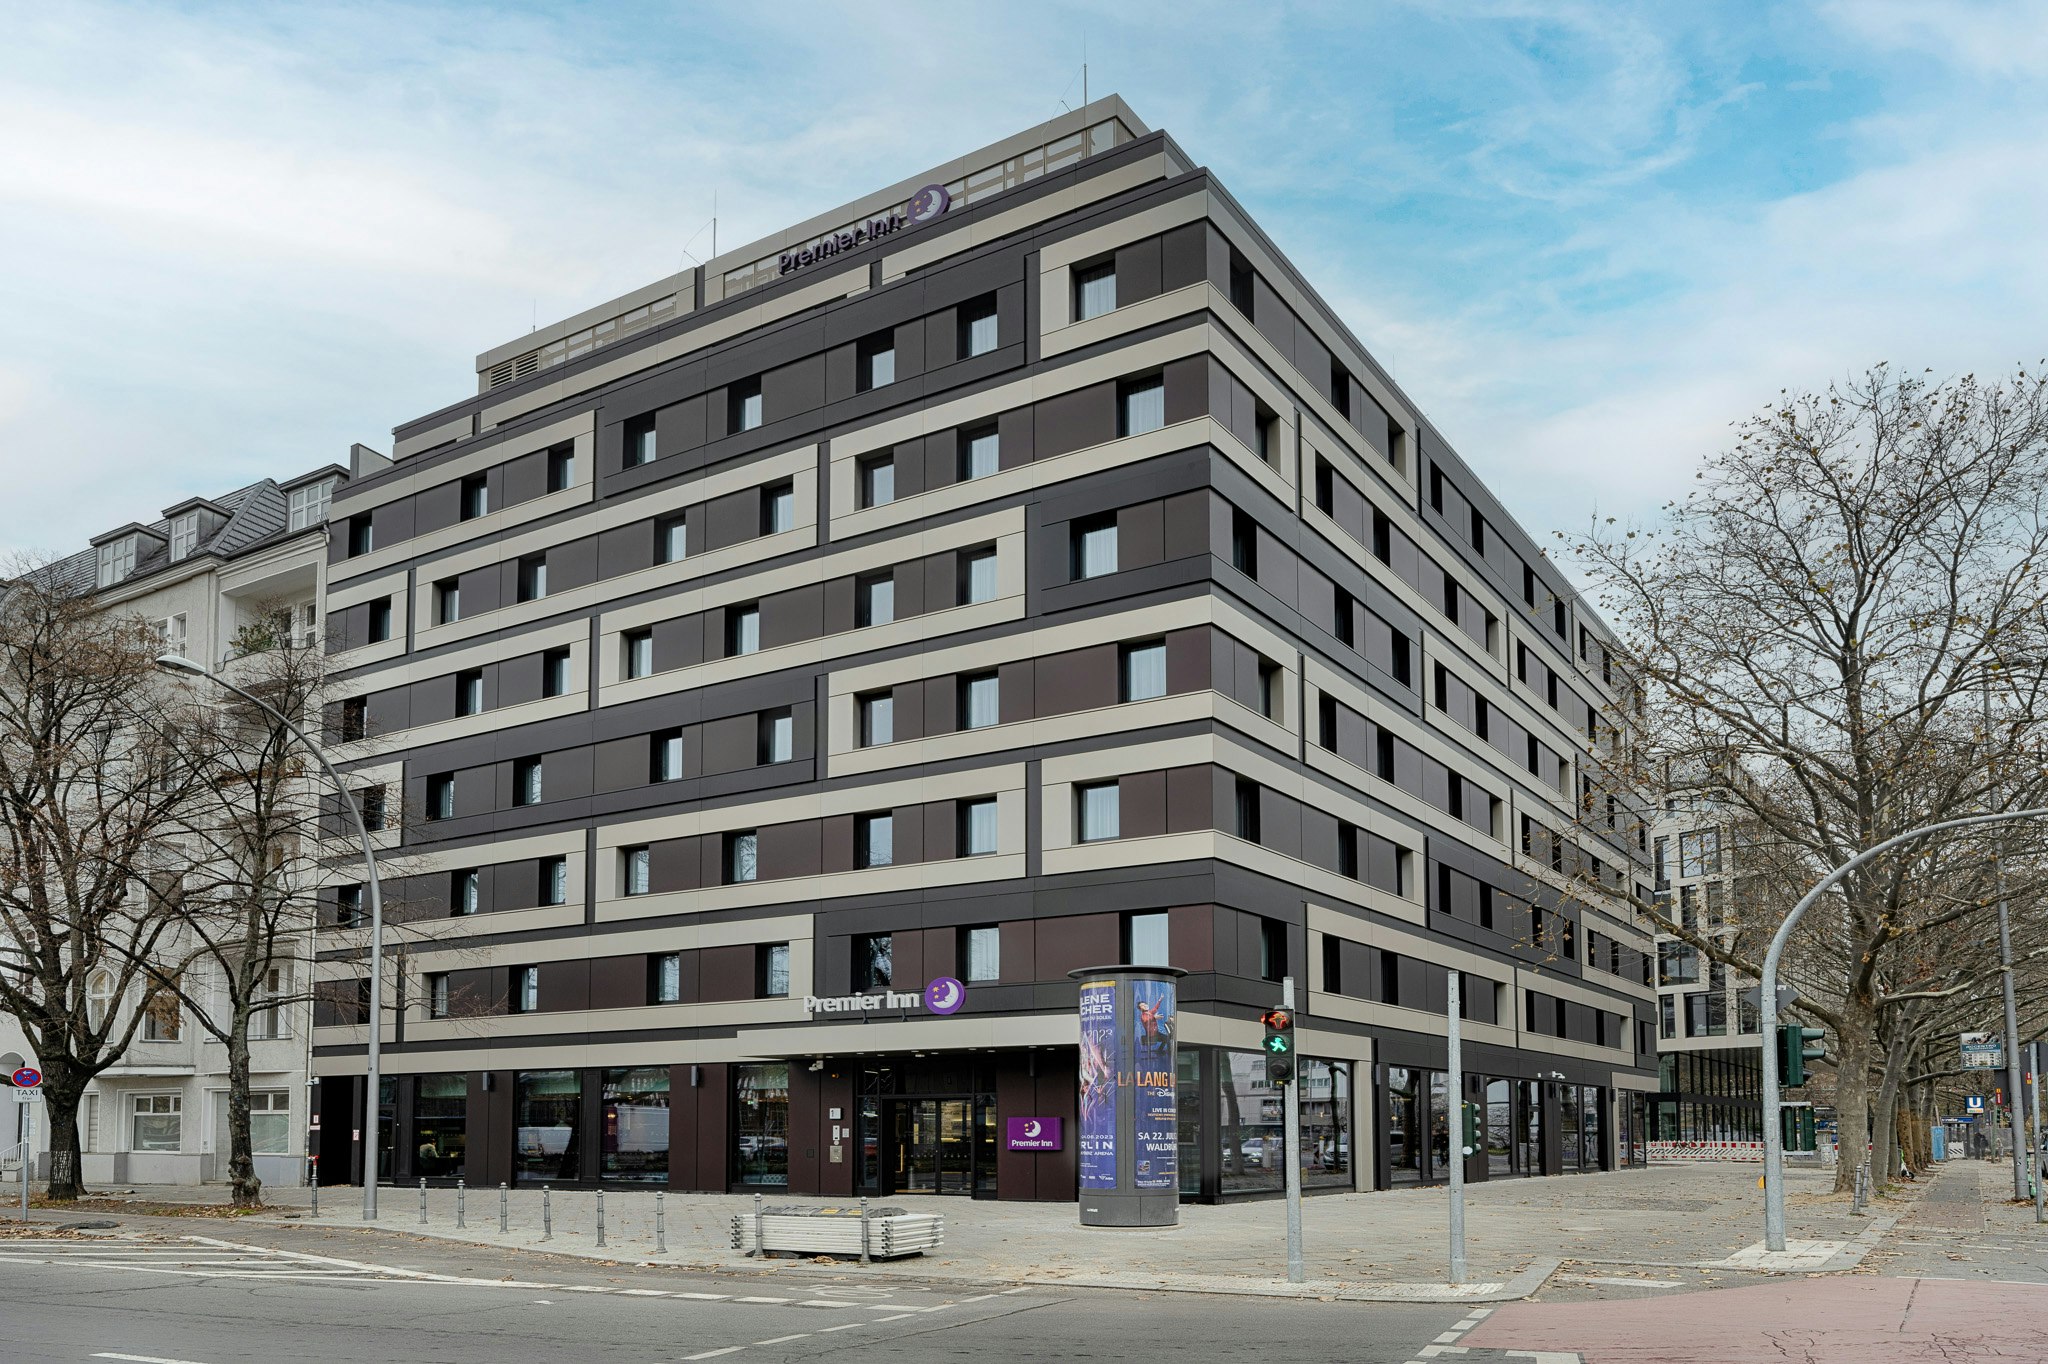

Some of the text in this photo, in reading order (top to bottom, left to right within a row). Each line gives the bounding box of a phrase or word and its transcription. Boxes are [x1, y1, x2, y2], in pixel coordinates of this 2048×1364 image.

[778, 213, 901, 275] Premier Inn
[803, 990, 920, 1013] Premier Inn
[1137, 1071, 1168, 1087] LANG
[1969, 1097, 1982, 1108] U
[1138, 1132, 1150, 1140] SA
